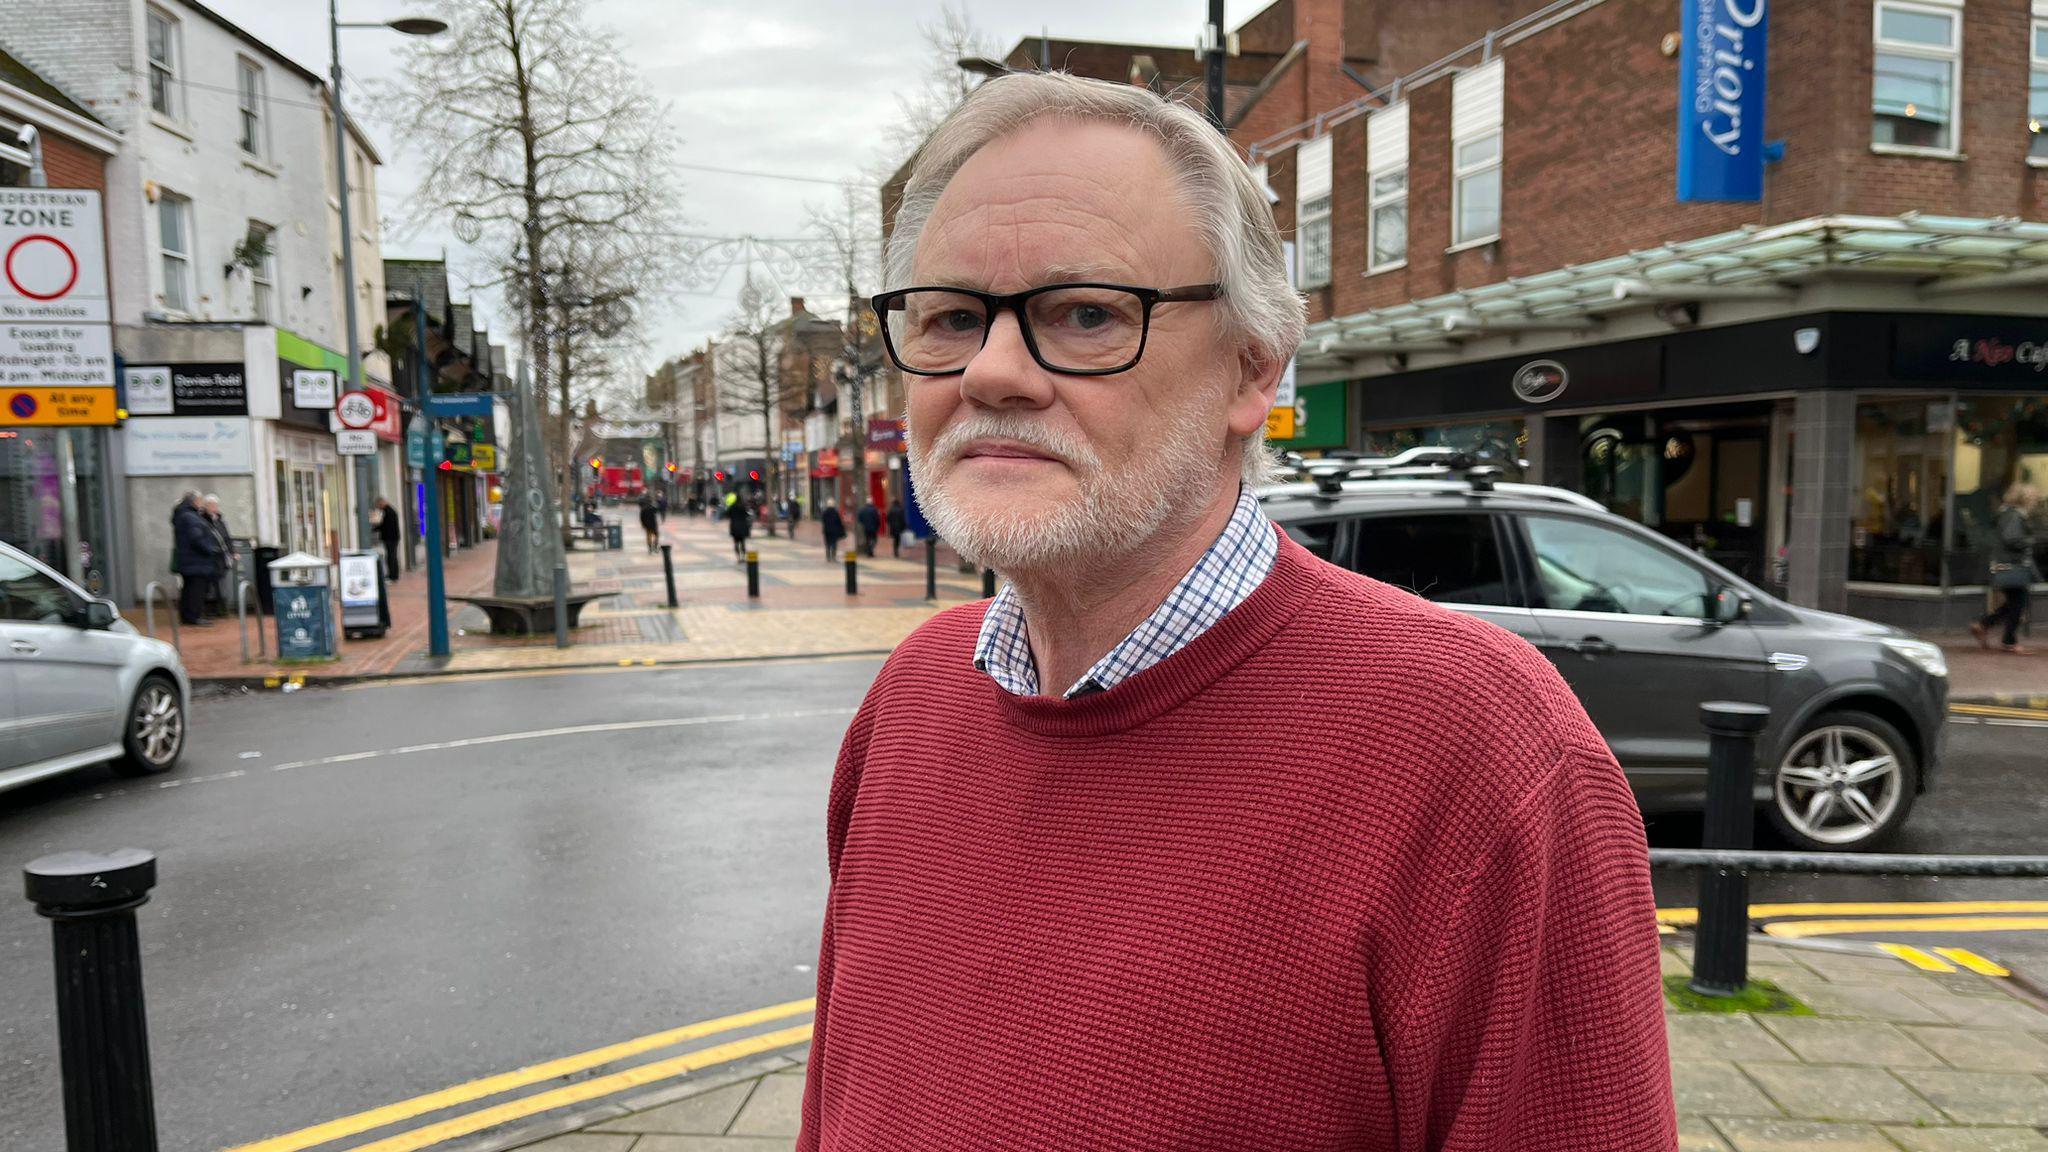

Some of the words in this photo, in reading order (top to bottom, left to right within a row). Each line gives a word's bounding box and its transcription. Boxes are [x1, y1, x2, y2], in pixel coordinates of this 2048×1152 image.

[0, 193, 88, 207] EDESTRIAN
[3, 209, 74, 227] ZONE
[3, 306, 24, 317] No
[28, 306, 87, 317] vehicles
[9, 327, 60, 340] Except
[62, 327, 83, 340] for
[20, 342, 75, 353] loading
[0, 355, 55, 367] idnight
[40, 370, 106, 382] Midnight
[70, 394, 96, 406] any
[57, 407, 90, 417] time
